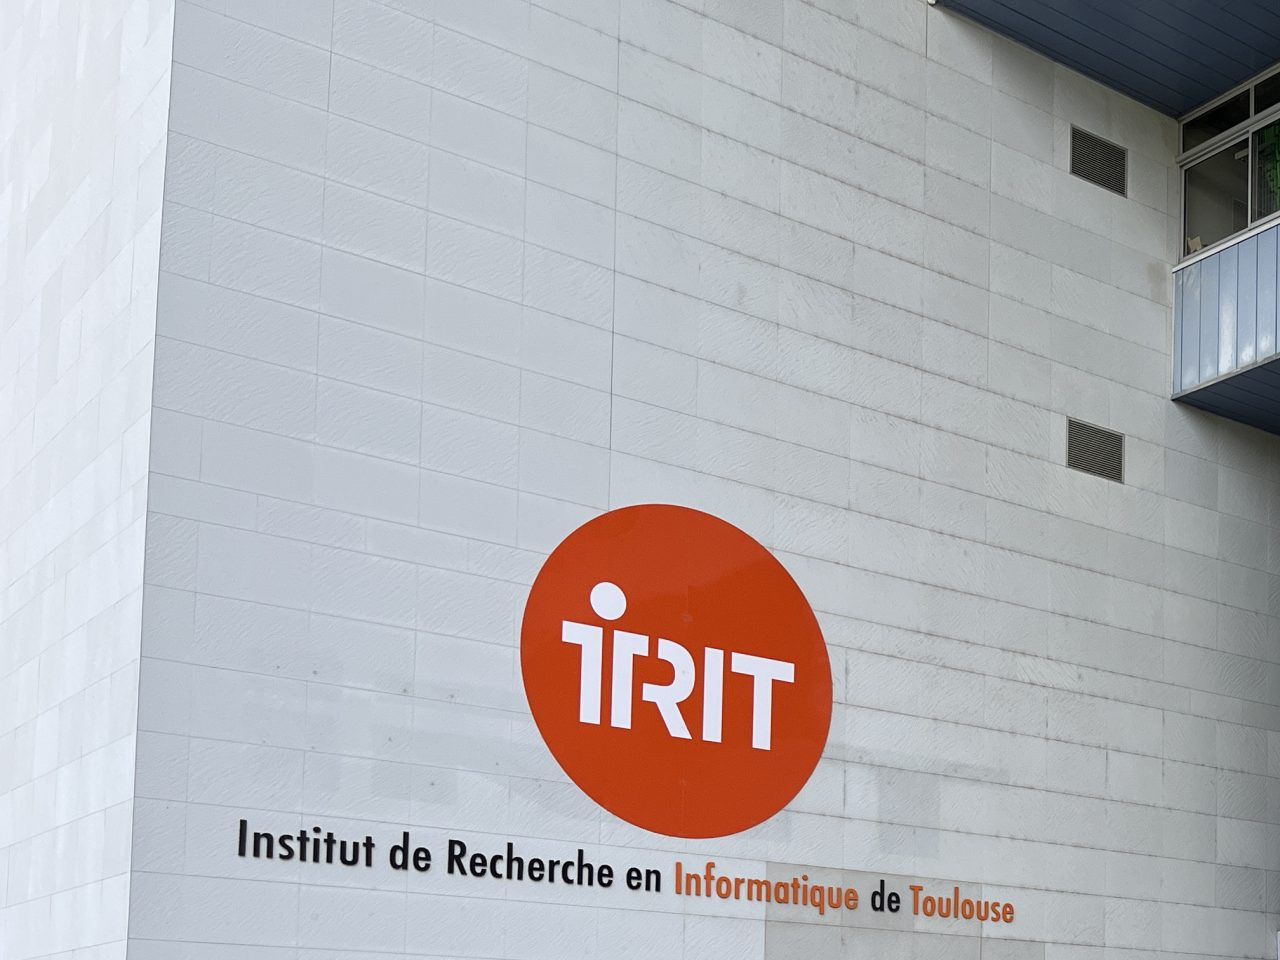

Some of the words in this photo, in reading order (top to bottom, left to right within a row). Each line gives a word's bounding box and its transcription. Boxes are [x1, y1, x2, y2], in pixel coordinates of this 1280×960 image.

[237, 819, 376, 870] Institut
[388, 831, 432, 874] de
[447, 839, 614, 889] Recherche
[626, 862, 662, 893] en
[674, 861, 859, 916] Informatique
[870, 880, 901, 915] de
[909, 884, 1015, 924] Toulouse
